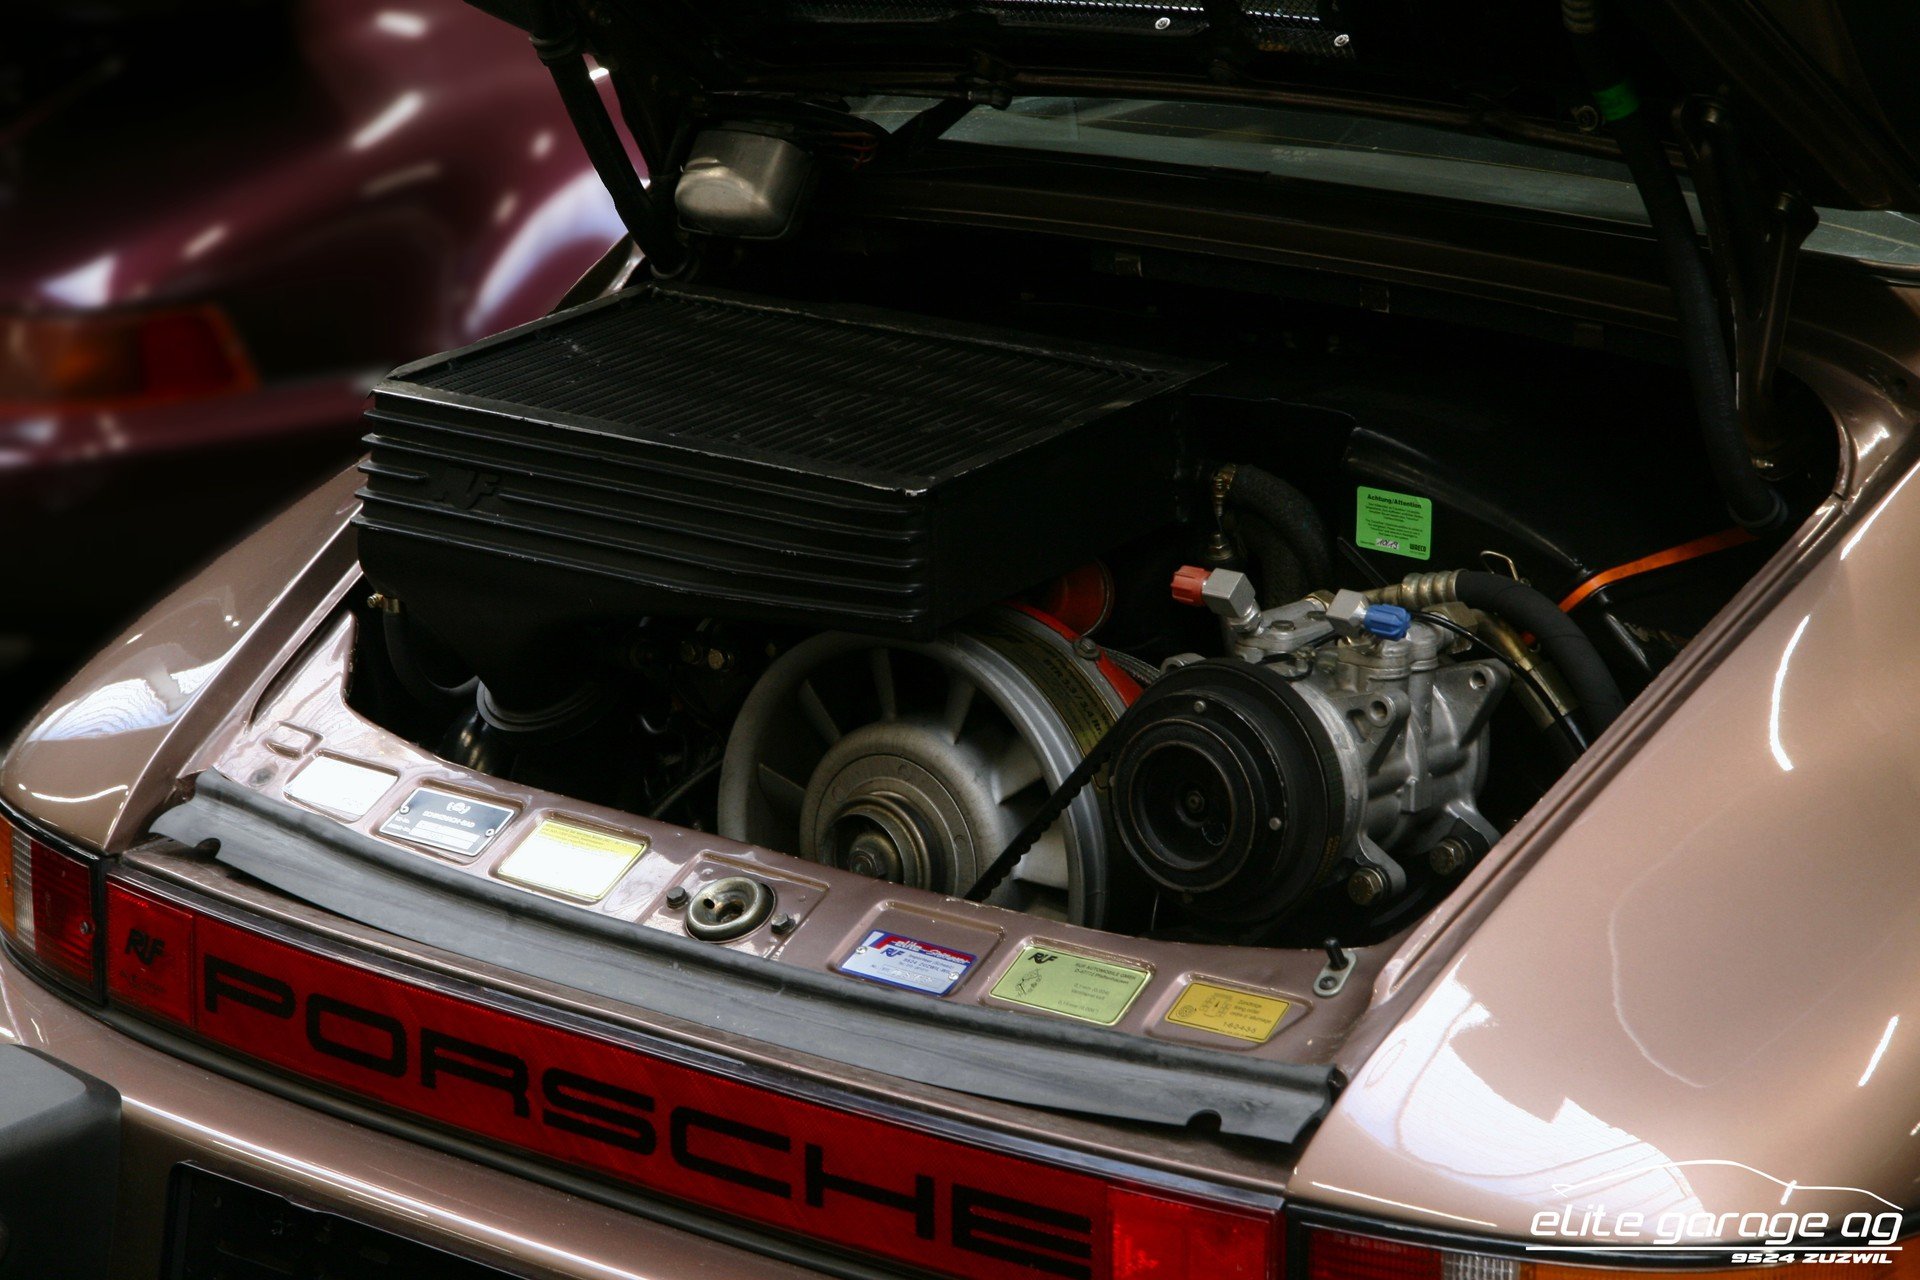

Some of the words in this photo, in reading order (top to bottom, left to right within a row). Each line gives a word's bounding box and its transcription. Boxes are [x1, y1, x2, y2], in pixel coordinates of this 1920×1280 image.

[1367, 493, 1422, 509] Achtung/Attention
[125, 928, 165, 965] RUF
[880, 947, 906, 958] RUF
[1028, 952, 1058, 964] RUF
[204, 957, 1092, 1272] PORSCHE
